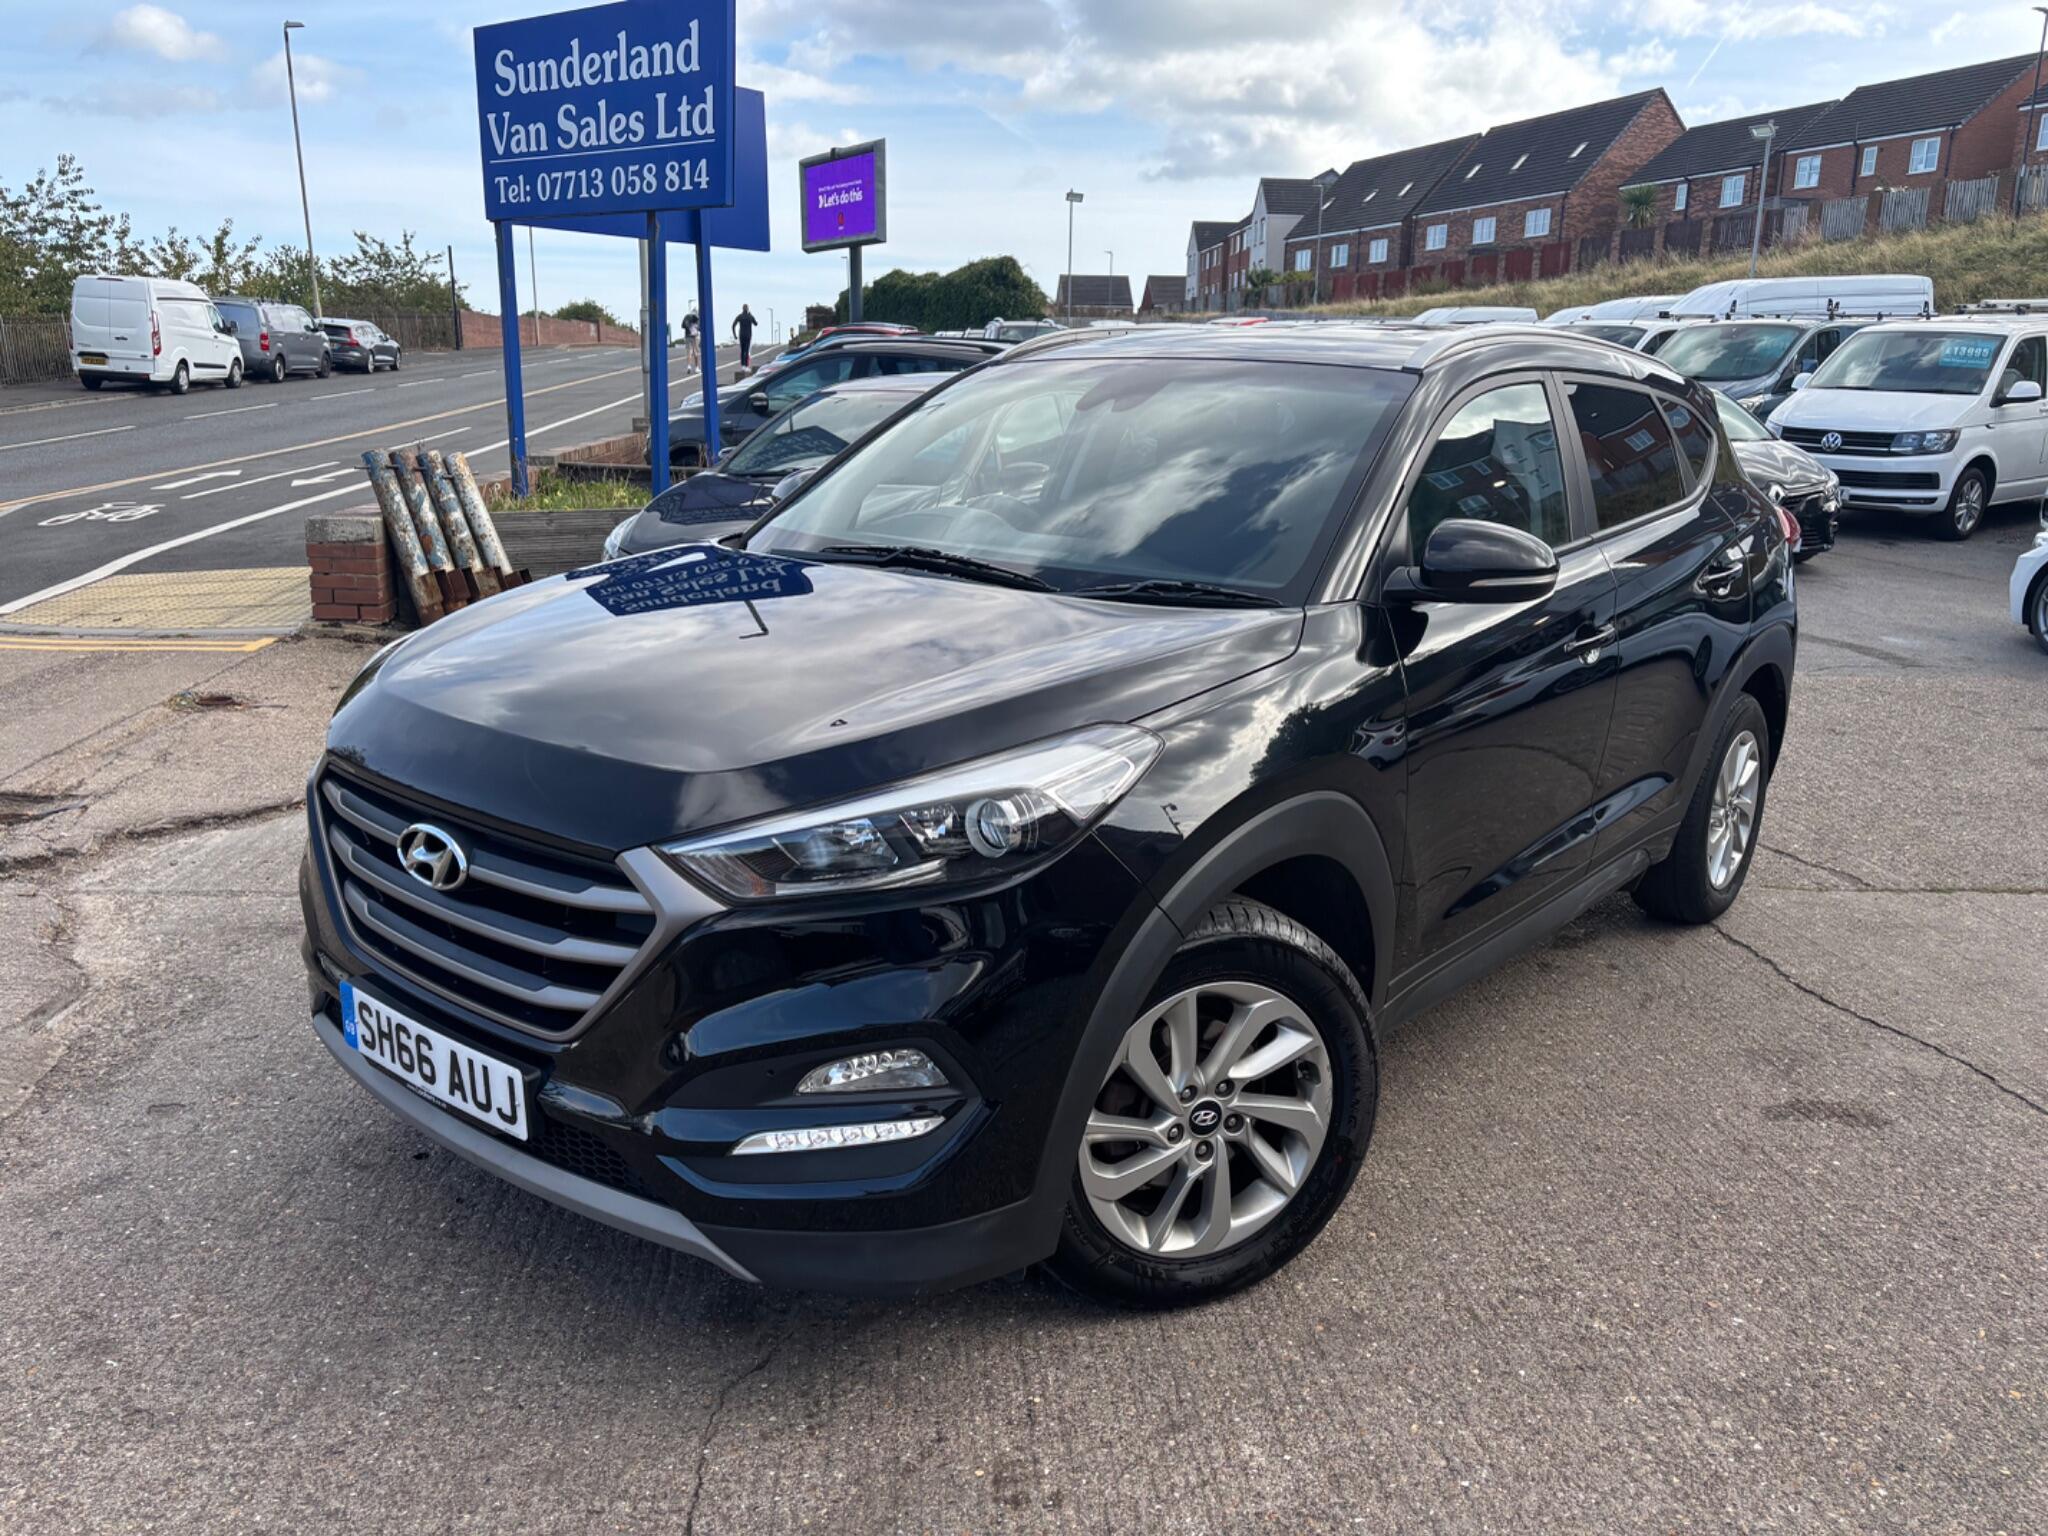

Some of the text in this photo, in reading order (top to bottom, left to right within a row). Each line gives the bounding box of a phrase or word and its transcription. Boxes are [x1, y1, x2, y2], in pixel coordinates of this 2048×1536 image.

[494, 18, 700, 97] Sunderland
[487, 85, 715, 155] Van Sales Ltd
[495, 158, 710, 204] Tel: 07713 058 814
[824, 187, 862, 207] Let's do this
[358, 1001, 518, 1126] SH66 AUJ
